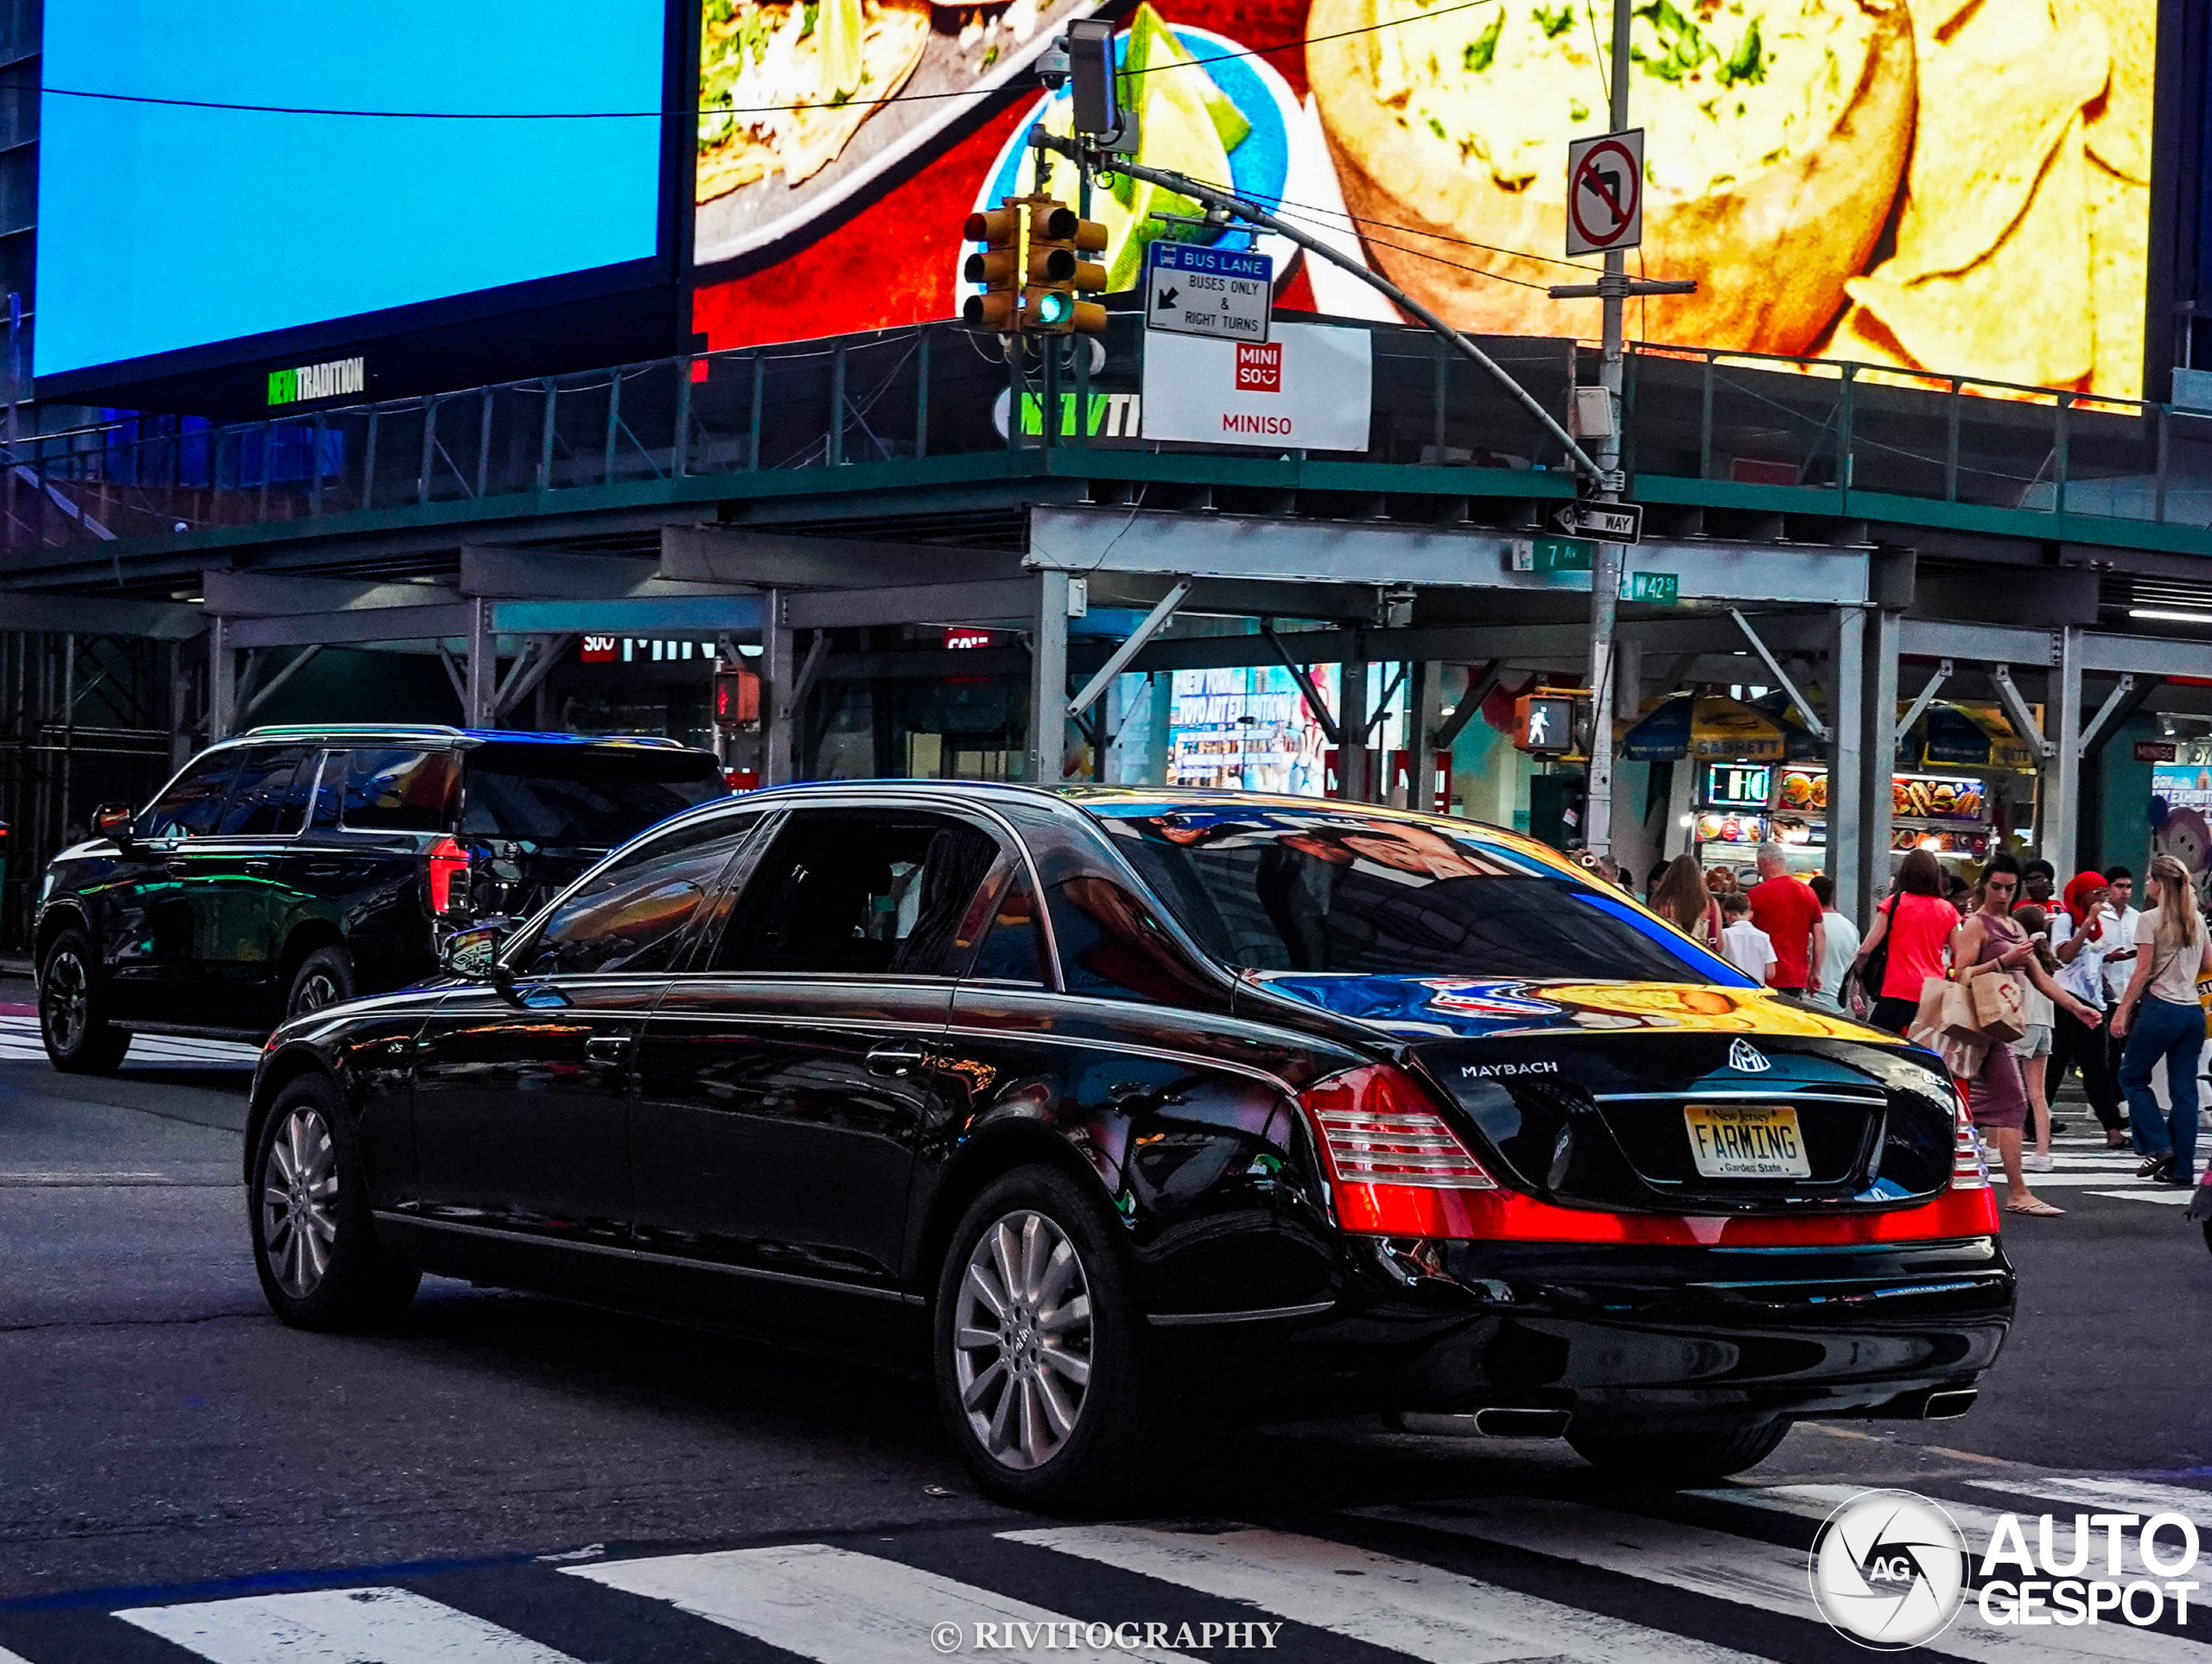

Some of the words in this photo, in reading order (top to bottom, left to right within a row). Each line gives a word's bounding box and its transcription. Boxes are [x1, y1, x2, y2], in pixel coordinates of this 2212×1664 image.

[1185, 252, 1216, 269] BUS
[1220, 257, 1263, 275] LANE
[1189, 275, 1225, 291] BUSES
[1230, 281, 1260, 295] ONLY
[1220, 297, 1229, 310] &
[1185, 311, 1217, 327] RIGHT
[1223, 315, 1258, 332] TURNS
[1240, 348, 1277, 365] MINI
[1223, 413, 1292, 435] MINISO
[1605, 514, 1630, 531] WAY
[1548, 545, 1557, 567] 7
[1636, 575, 1647, 596] W
[1648, 577, 1664, 599] 42
[1461, 1062, 1558, 1077] MAYBACH
[1713, 1109, 1736, 1121] New
[1738, 1109, 1770, 1123] Jersey
[1695, 1124, 1797, 1159] FARMING
[1725, 1163, 1757, 1172] Garden
[1758, 1163, 1783, 1172] State
